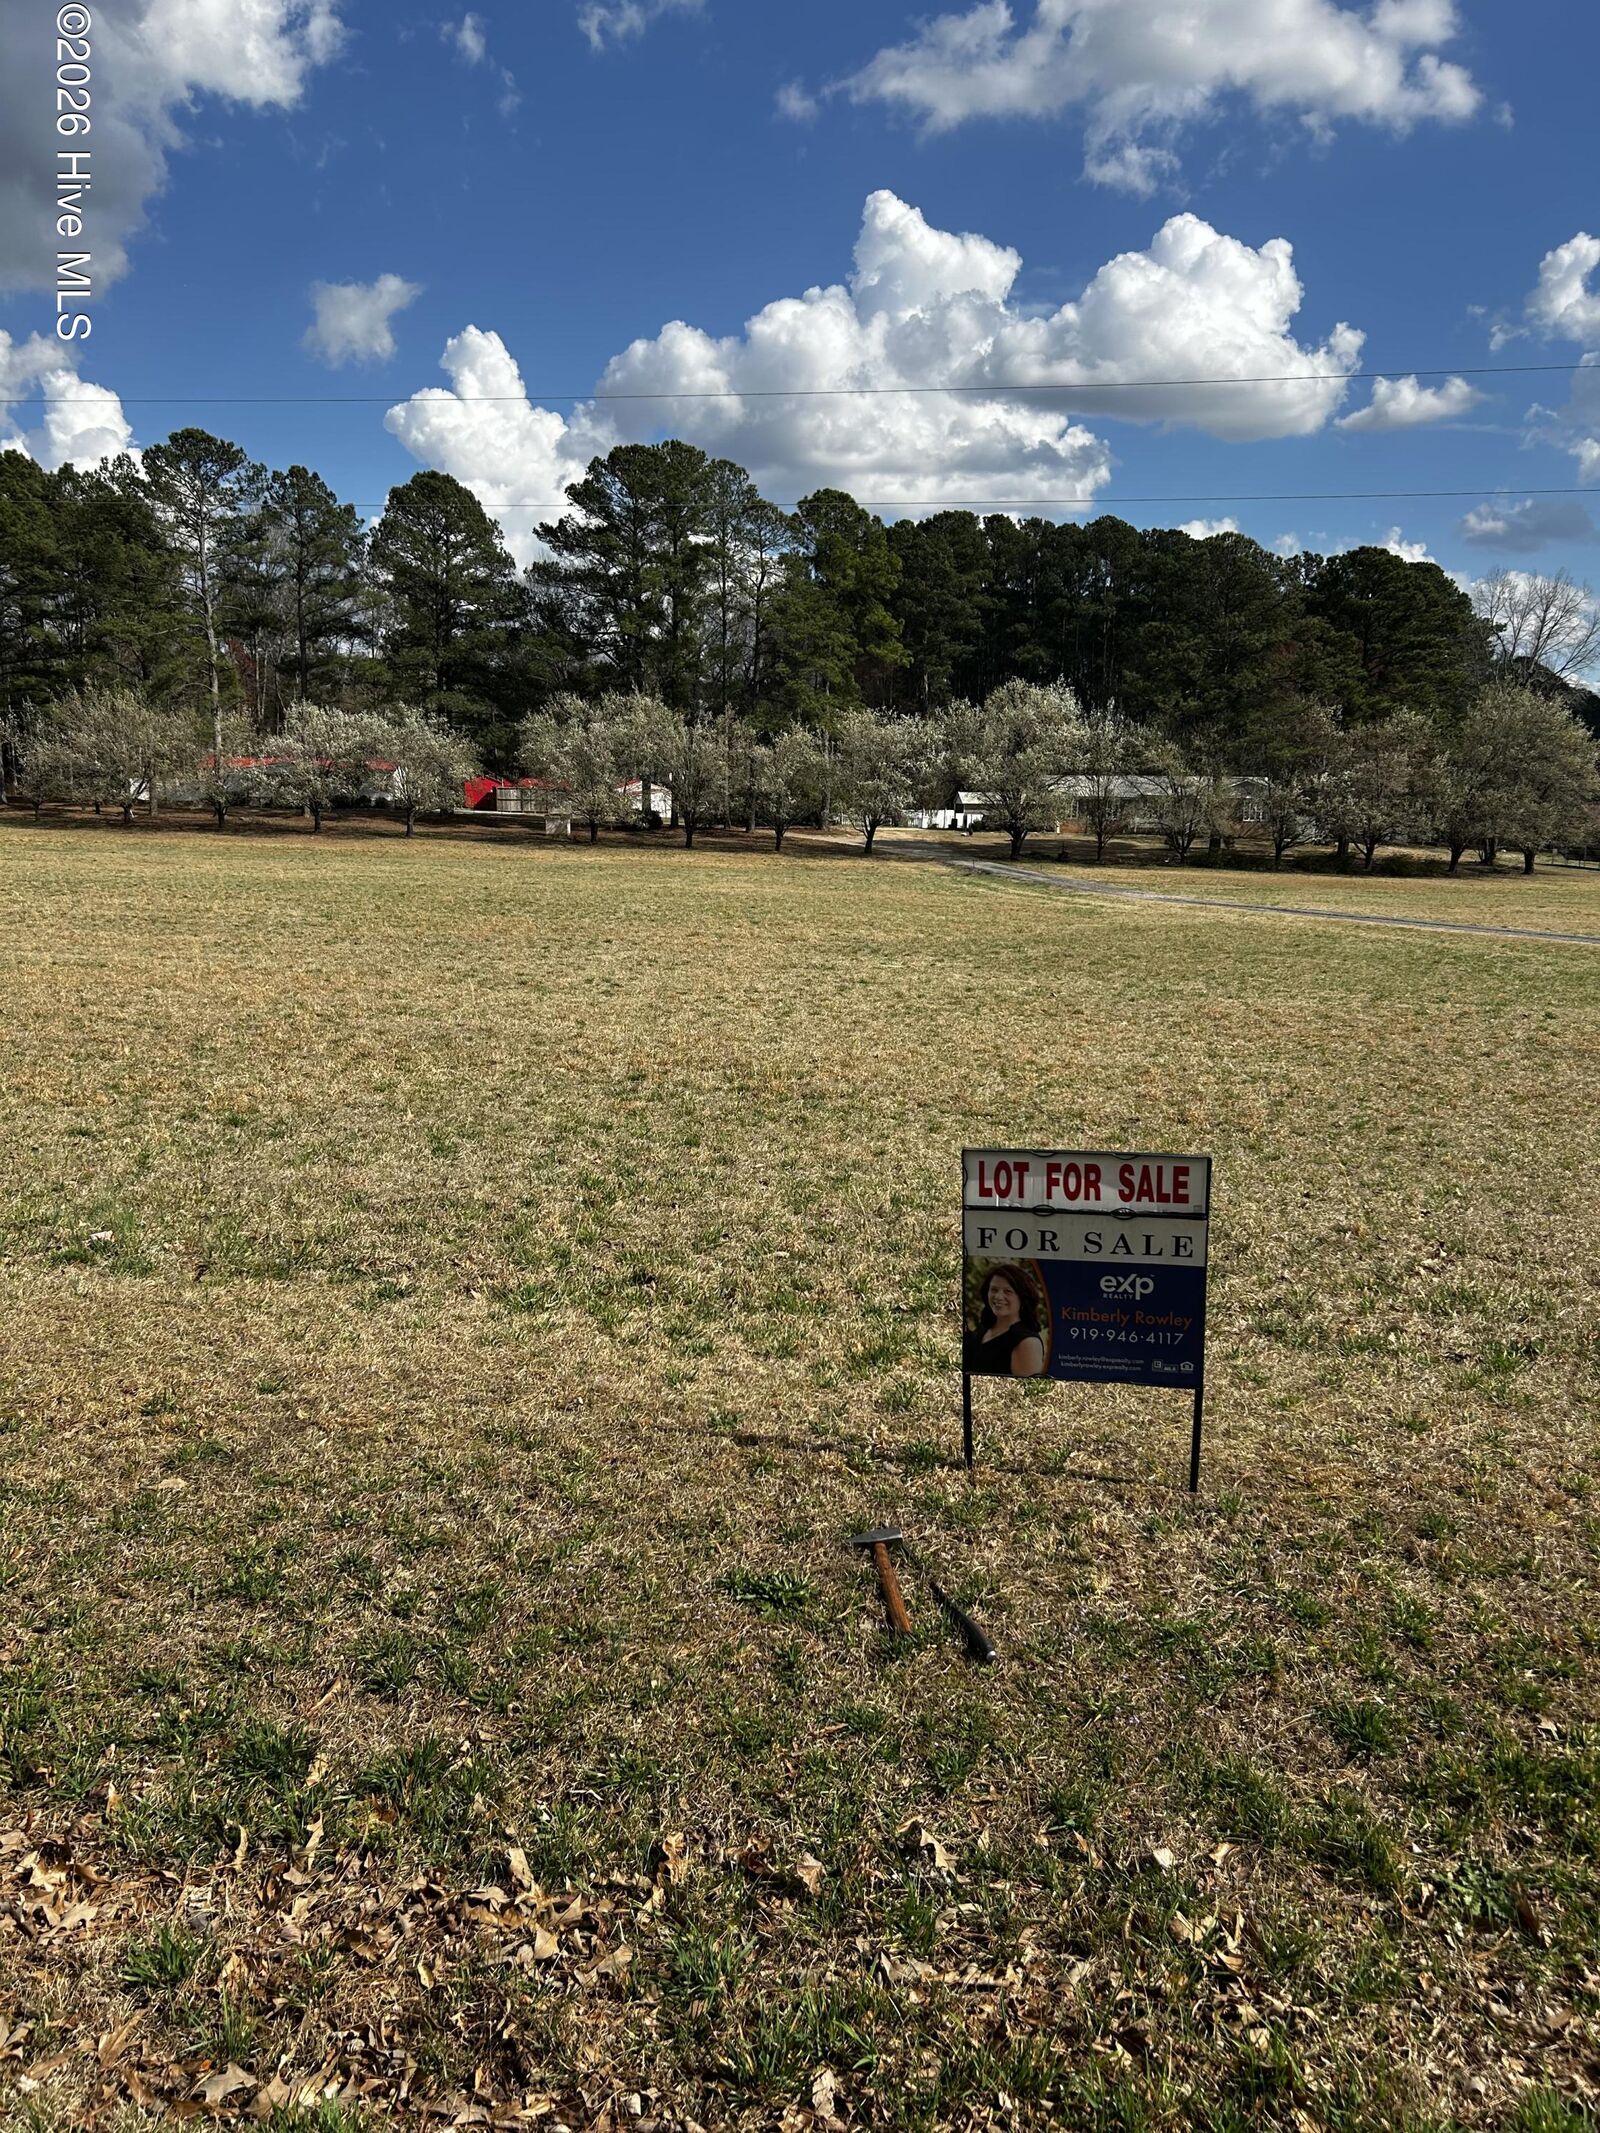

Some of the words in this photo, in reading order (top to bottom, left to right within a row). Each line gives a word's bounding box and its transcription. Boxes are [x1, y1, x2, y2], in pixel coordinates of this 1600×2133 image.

[978, 1160, 1029, 1199] LOT
[1046, 1162, 1102, 1201] FOR
[1118, 1164, 1190, 1204] SALE
[977, 1227, 1060, 1252] FOR
[1084, 1231, 1194, 1258] SALE
[1060, 1306, 1130, 1328] Kimberly
[1135, 1310, 1193, 1331] Rowley
